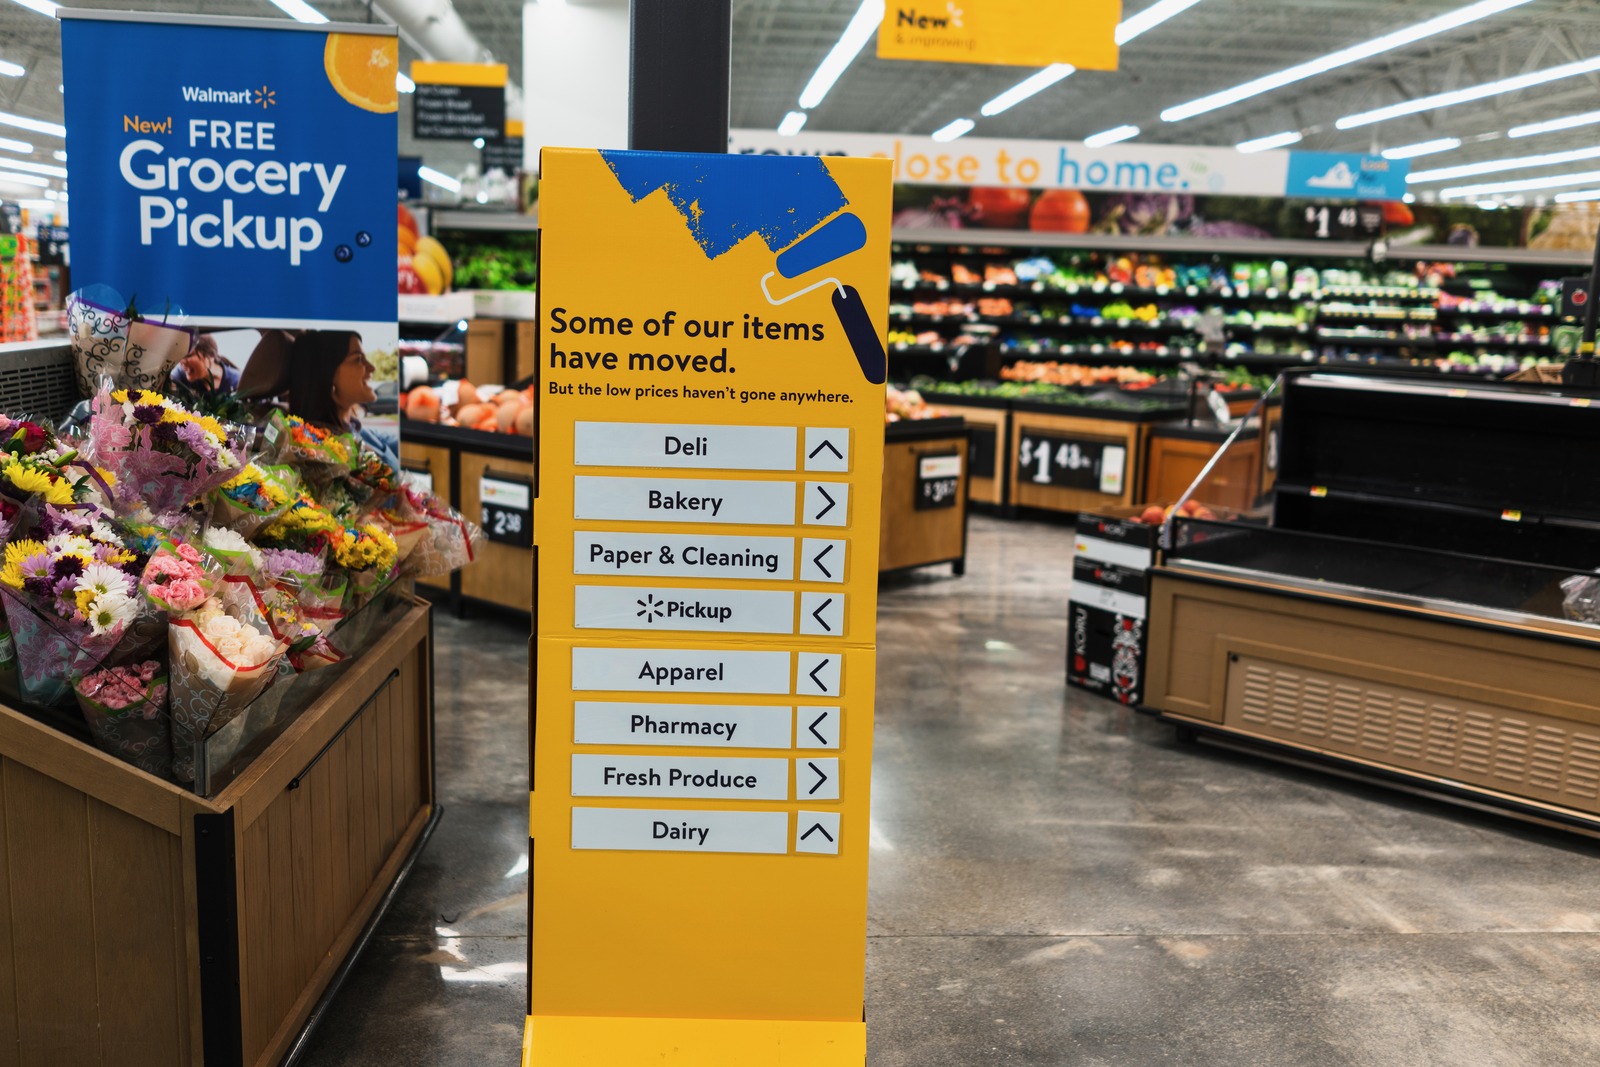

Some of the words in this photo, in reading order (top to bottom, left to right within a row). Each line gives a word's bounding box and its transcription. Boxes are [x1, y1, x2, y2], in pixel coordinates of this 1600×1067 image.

[896, 8, 950, 29] New
[182, 86, 252, 104] Walmart
[123, 115, 172, 135] New!
[189, 119, 276, 151] FREE
[118, 139, 347, 213] Grocery
[870, 139, 980, 182] lose
[996, 148, 1041, 184] to
[1057, 147, 1189, 188] home.
[139, 195, 323, 267] Pickup
[551, 308, 634, 336] Some
[643, 309, 677, 337] of
[684, 319, 735, 339] our
[743, 314, 825, 342] items
[551, 343, 619, 370] have
[629, 347, 736, 374] moved.
[549, 381, 573, 395] But
[578, 382, 602, 396] the
[607, 383, 630, 397] low
[635, 384, 678, 401] prices
[683, 385, 736, 400] haven’t
[740, 390, 775, 404] gone
[779, 388, 853, 406] anywhere.
[664, 436, 708, 456] Deli
[648, 490, 724, 517] Bakery
[590, 543, 653, 569] Paper
[659, 546, 675, 565] &
[682, 545, 779, 573] Cleaning
[667, 601, 733, 622] Pickup
[638, 660, 724, 686] Apparel
[631, 714, 738, 743] Pharmacy
[603, 766, 661, 786] Fresh
[669, 768, 757, 789] Produce
[652, 821, 710, 846] Dairy
